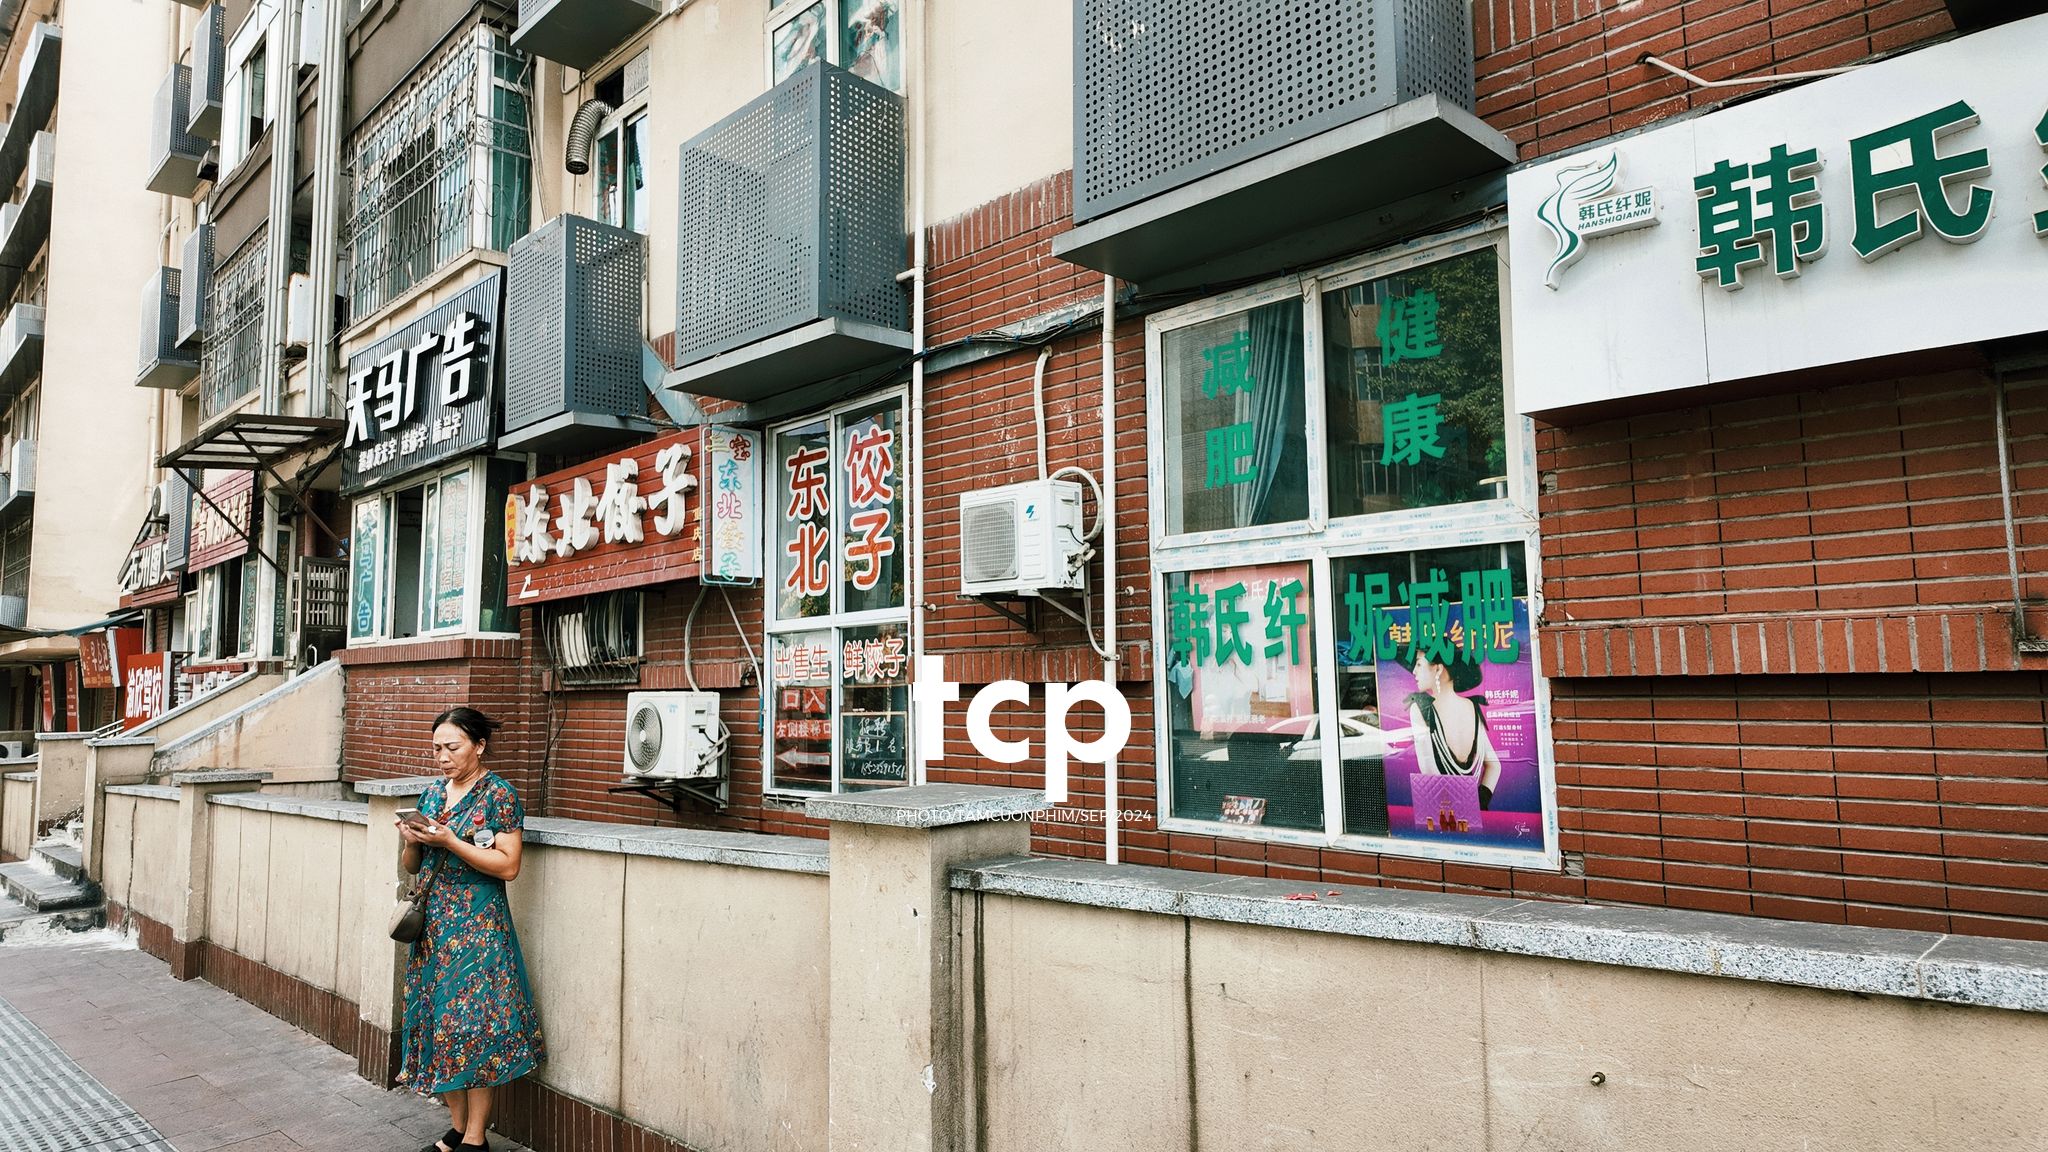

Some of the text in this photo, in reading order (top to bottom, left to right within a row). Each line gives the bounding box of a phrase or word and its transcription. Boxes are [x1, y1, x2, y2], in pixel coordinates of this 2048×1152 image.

[1578, 190, 1651, 221] 韩氏纤妮
[1578, 207, 1652, 231] HANSHIQIANNI
[1694, 100, 2048, 288] 韩氏
[343, 310, 476, 449] 天马广告
[1202, 331, 1257, 489] 减肥
[1375, 289, 1447, 466] 健康
[786, 445, 831, 598] 东北
[844, 424, 895, 591] 饺子
[774, 638, 906, 681] 出售生 鲜饺子
[1171, 568, 1520, 667] 韩氏纤 妮减肥
